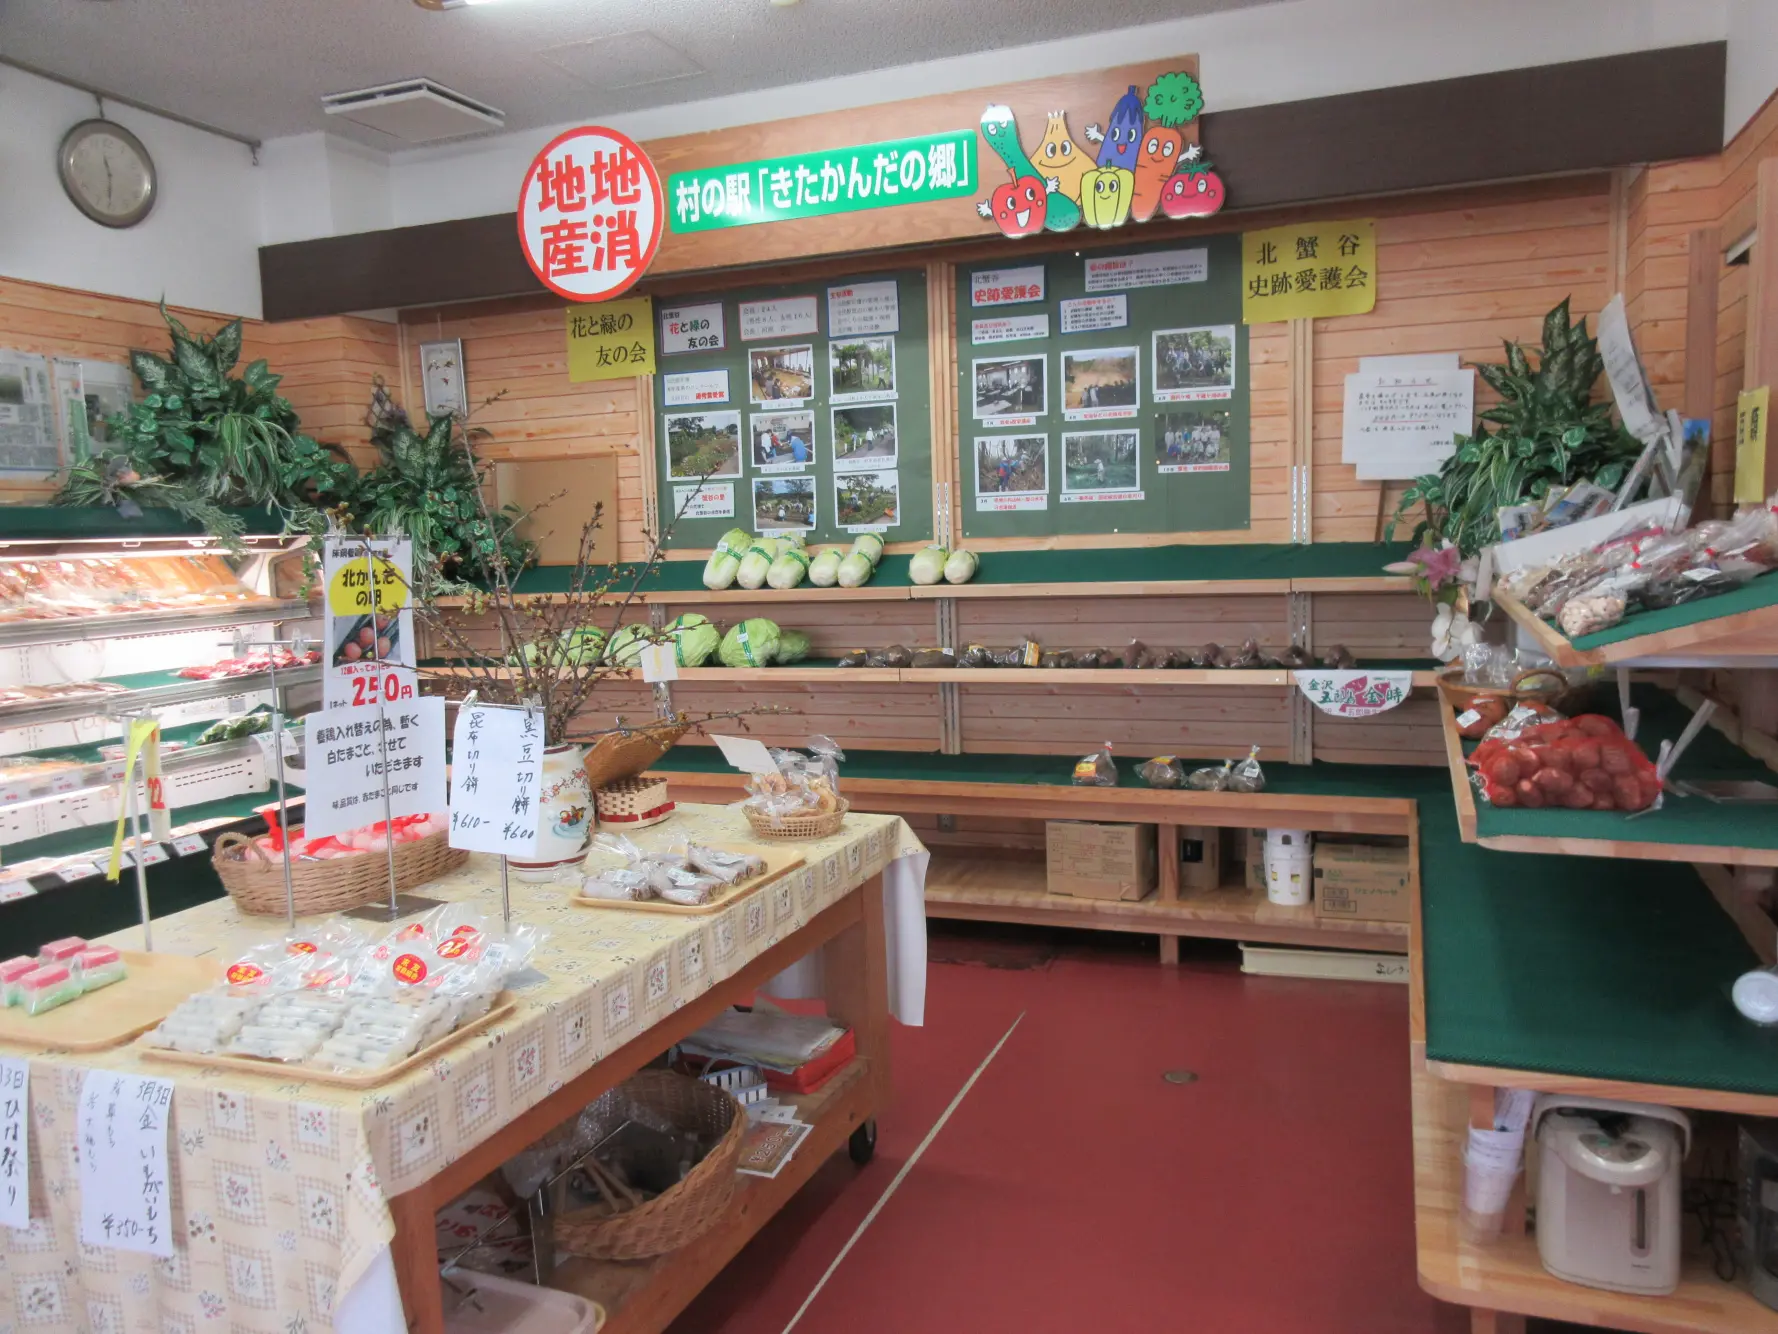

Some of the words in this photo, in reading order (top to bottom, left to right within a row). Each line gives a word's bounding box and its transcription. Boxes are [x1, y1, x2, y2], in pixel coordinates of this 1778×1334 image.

[676, 140, 969, 223] 村の駅「きたかんだの郷」
[1248, 265, 1369, 298] 史跡愛護会
[974, 284, 1041, 303] 史跡愛護会
[569, 312, 634, 340] 花と緑の
[669, 318, 710, 335] 花と緑の
[687, 335, 719, 349] 友の会
[595, 341, 647, 368] 友の会
[1308, 679, 1334, 691] 金沢
